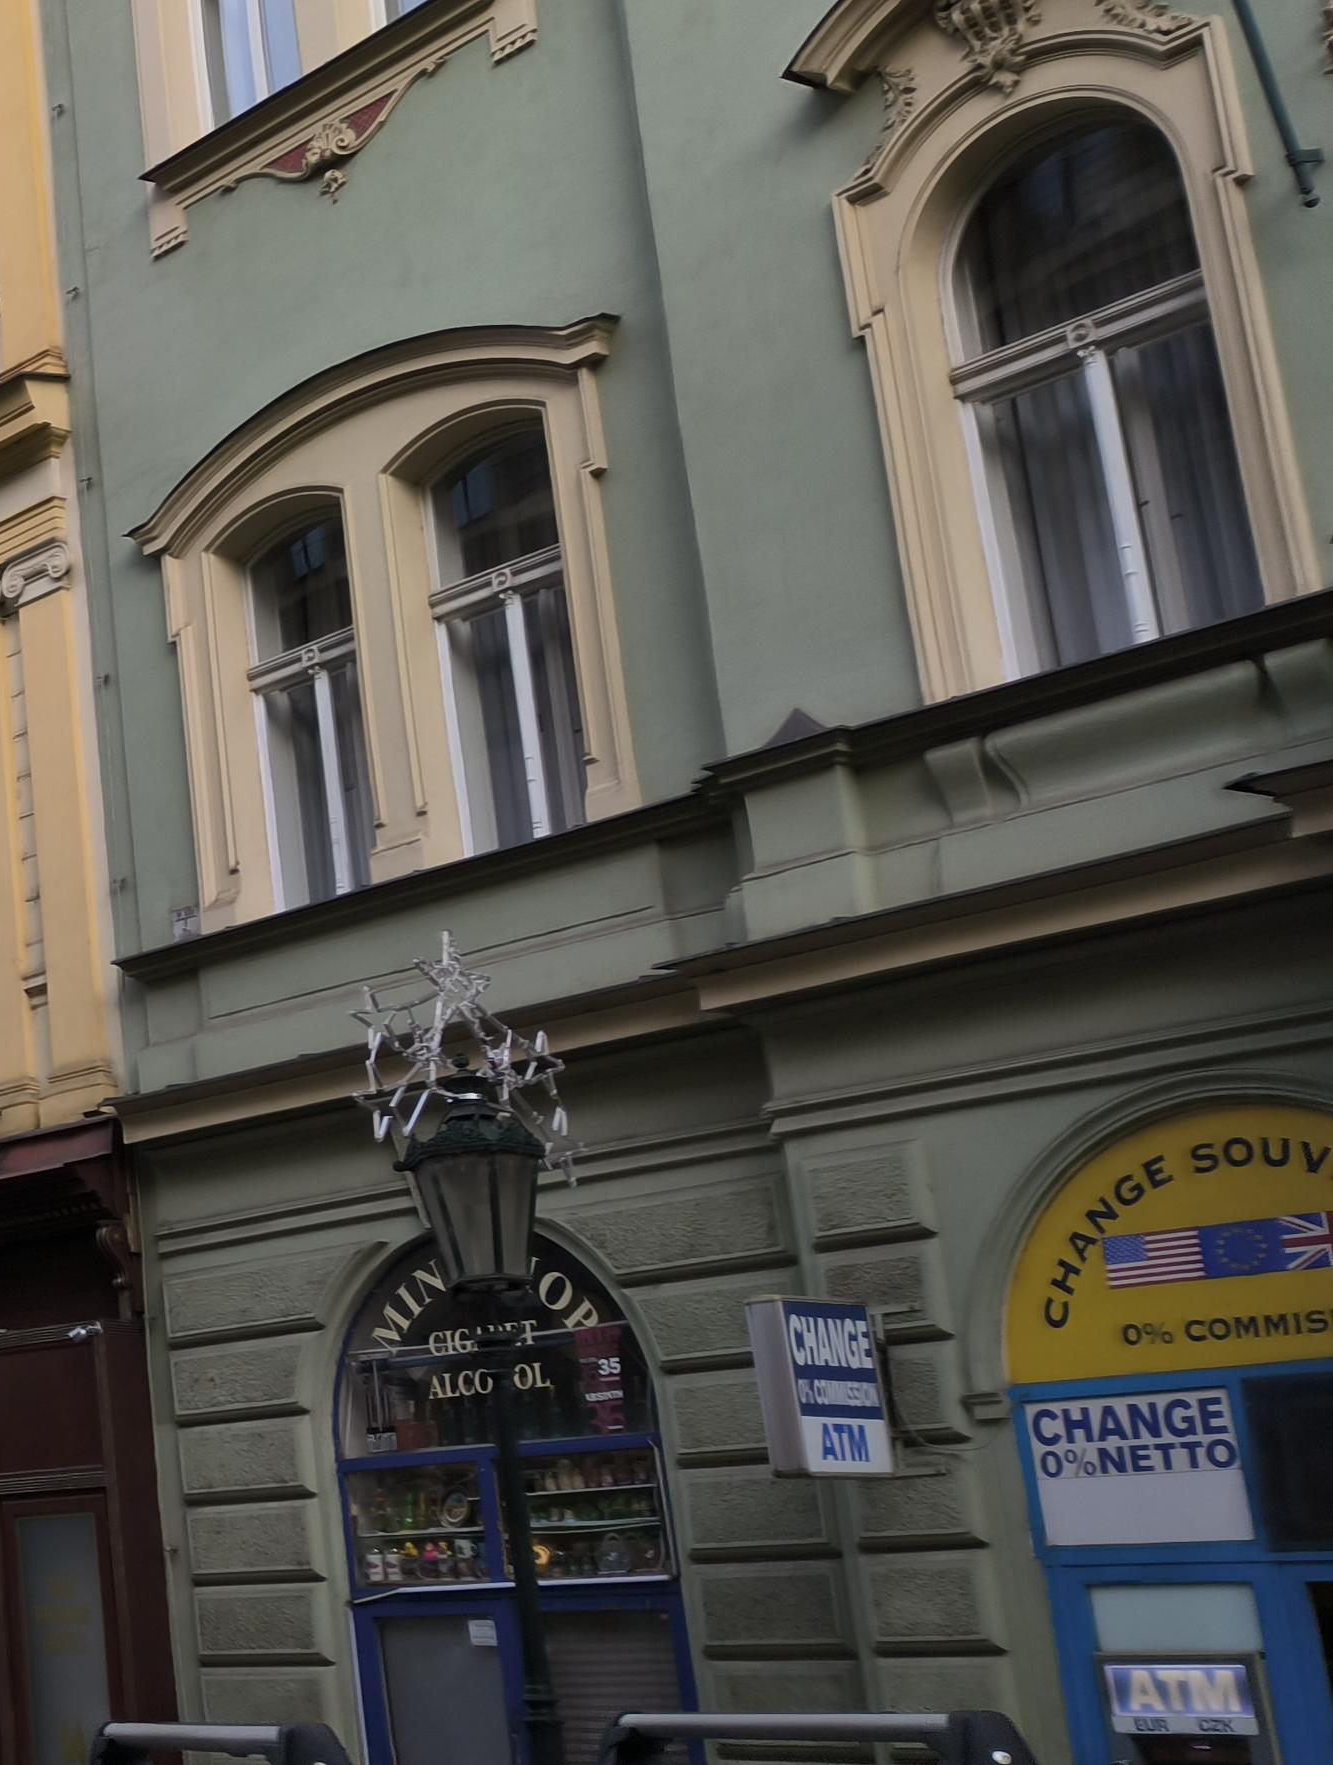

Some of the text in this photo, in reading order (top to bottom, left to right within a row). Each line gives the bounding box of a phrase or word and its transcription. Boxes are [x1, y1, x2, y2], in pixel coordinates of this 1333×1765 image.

[1044, 1137, 1333, 1329] CHANGE SOUV
[371, 1258, 447, 1356] MIN
[1123, 1308, 1333, 1346] 0% COMMIS
[789, 1313, 874, 1369] CHANGE
[429, 1362, 555, 1400] ALCOOL
[598, 1357, 621, 1375] 35
[822, 1423, 870, 1462] ATM
[1033, 1397, 1229, 1446] CHANGE
[1130, 1669, 1242, 1713] ATM
